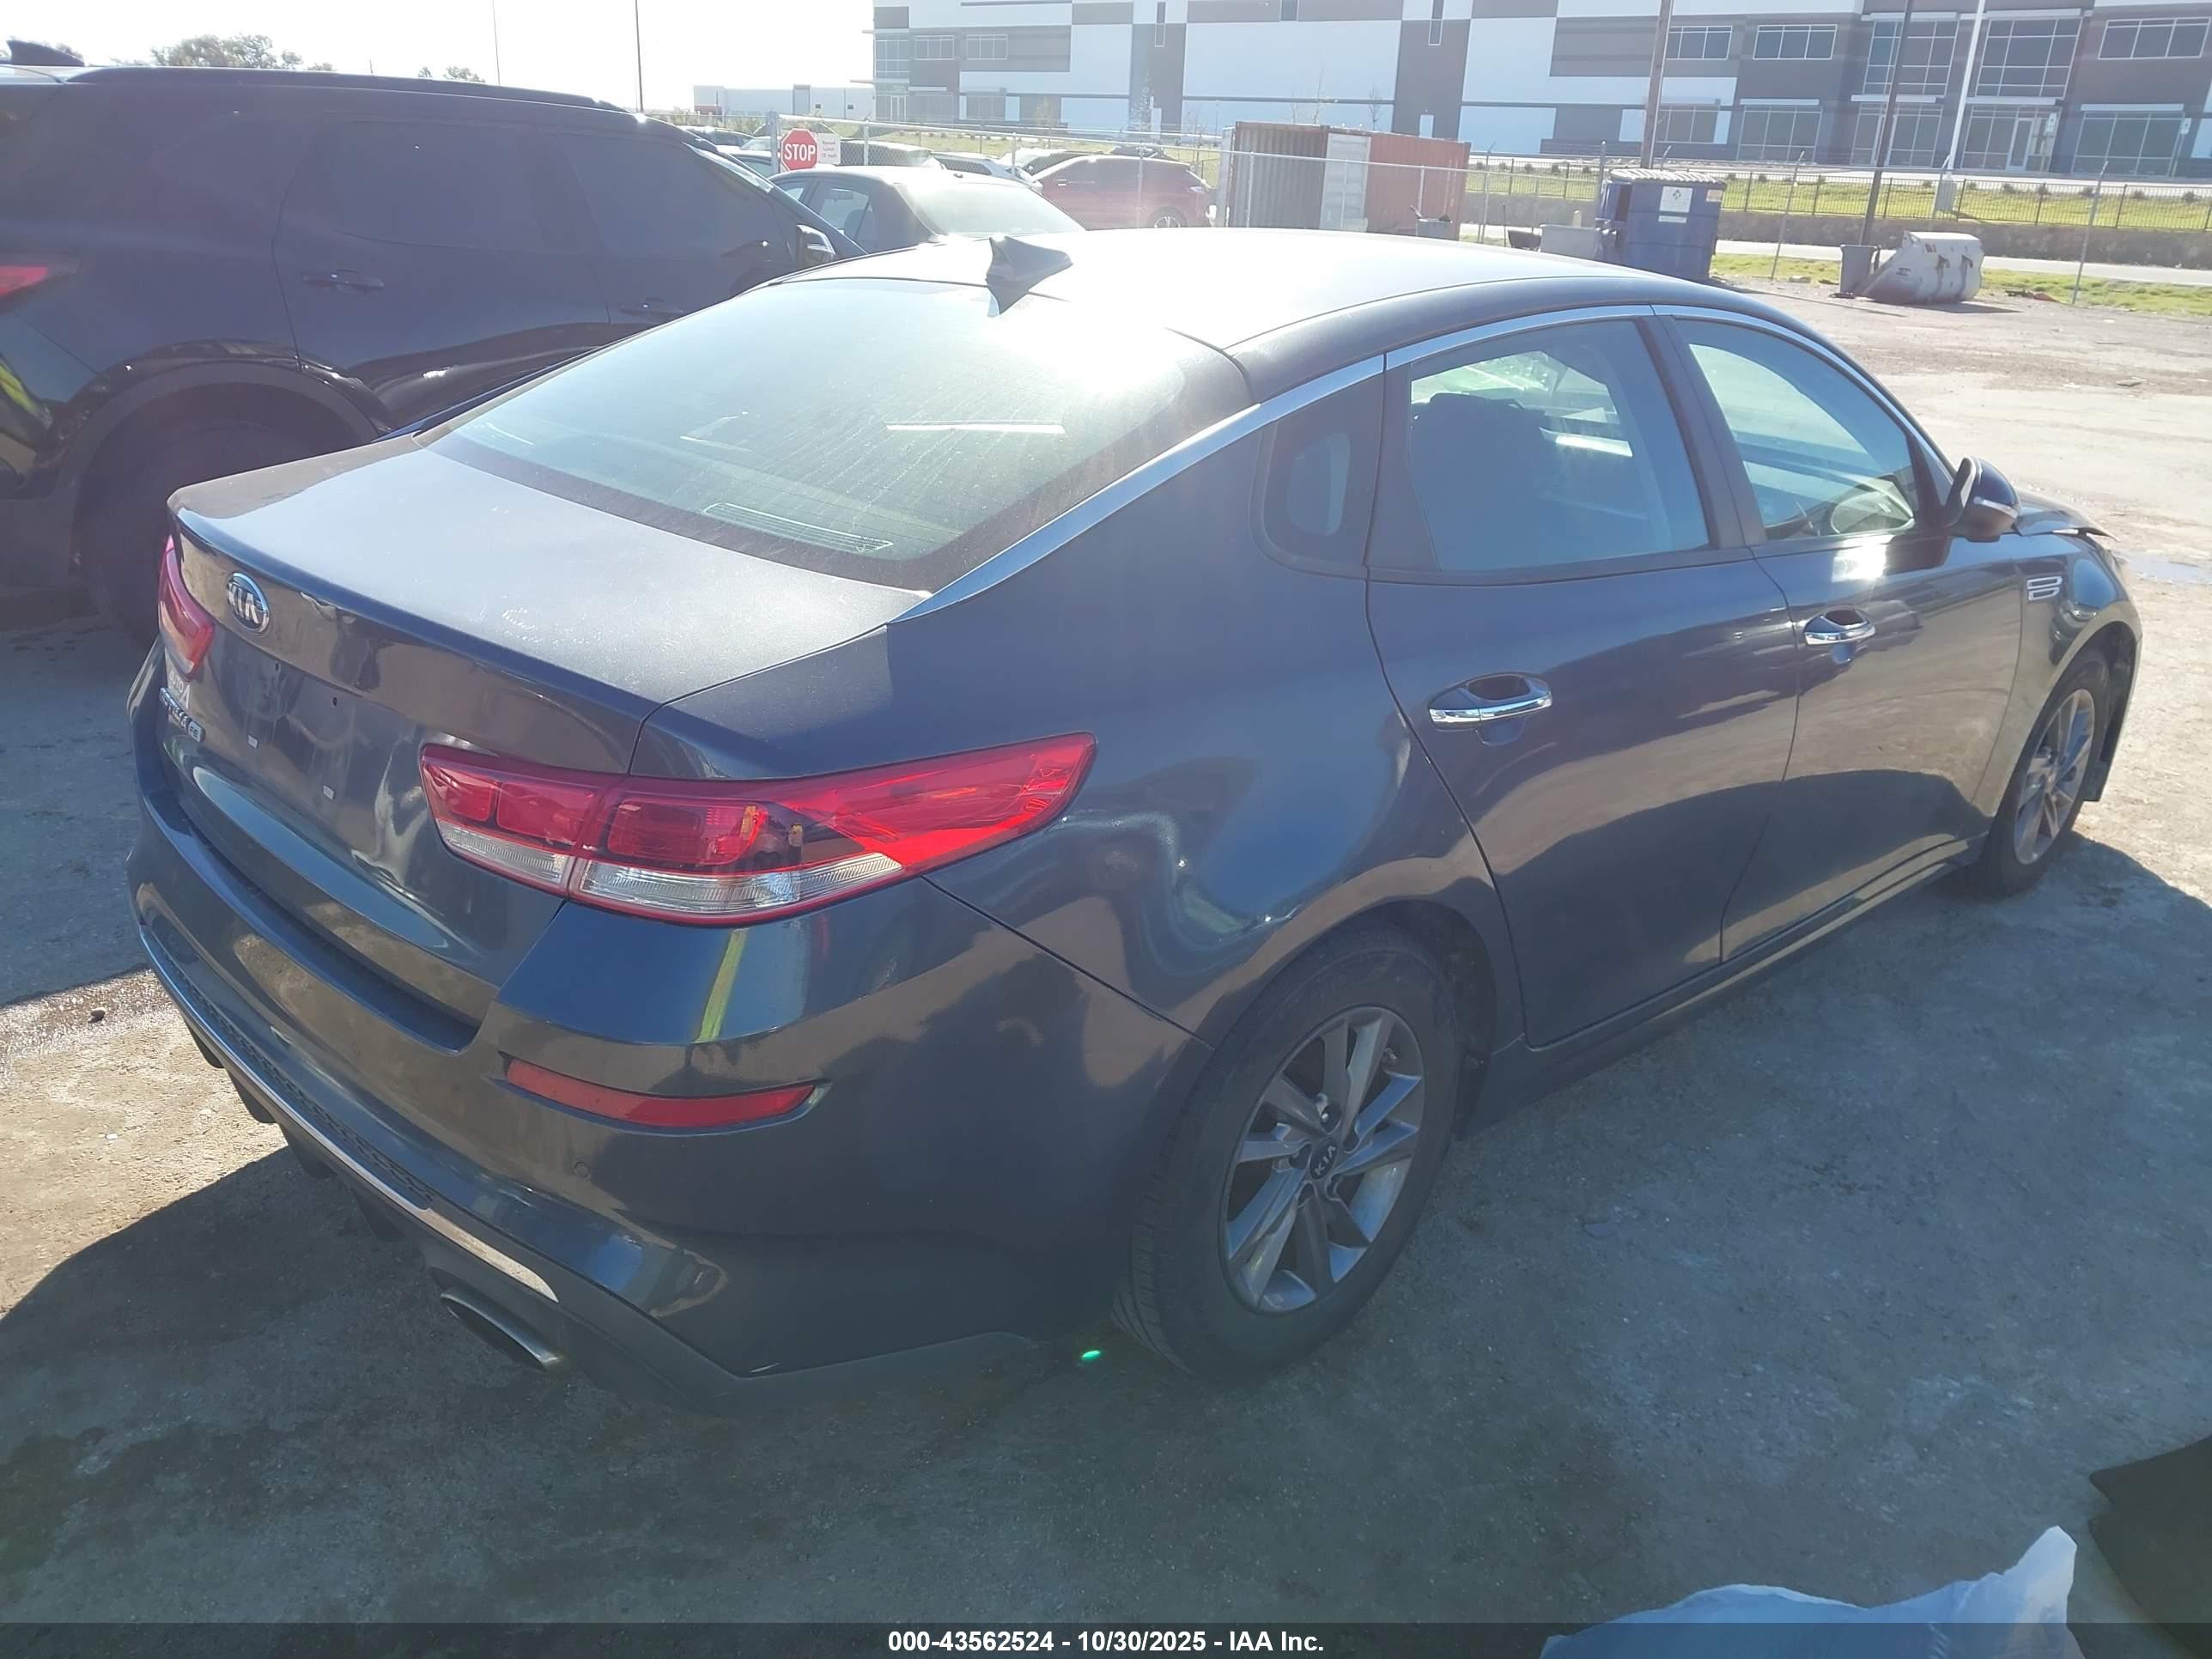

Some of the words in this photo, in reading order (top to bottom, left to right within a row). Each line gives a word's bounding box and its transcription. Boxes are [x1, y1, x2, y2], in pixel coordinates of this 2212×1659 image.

[784, 143, 816, 161] STOP
[228, 582, 260, 625] KIA
[1314, 1146, 1336, 1176] KIA
